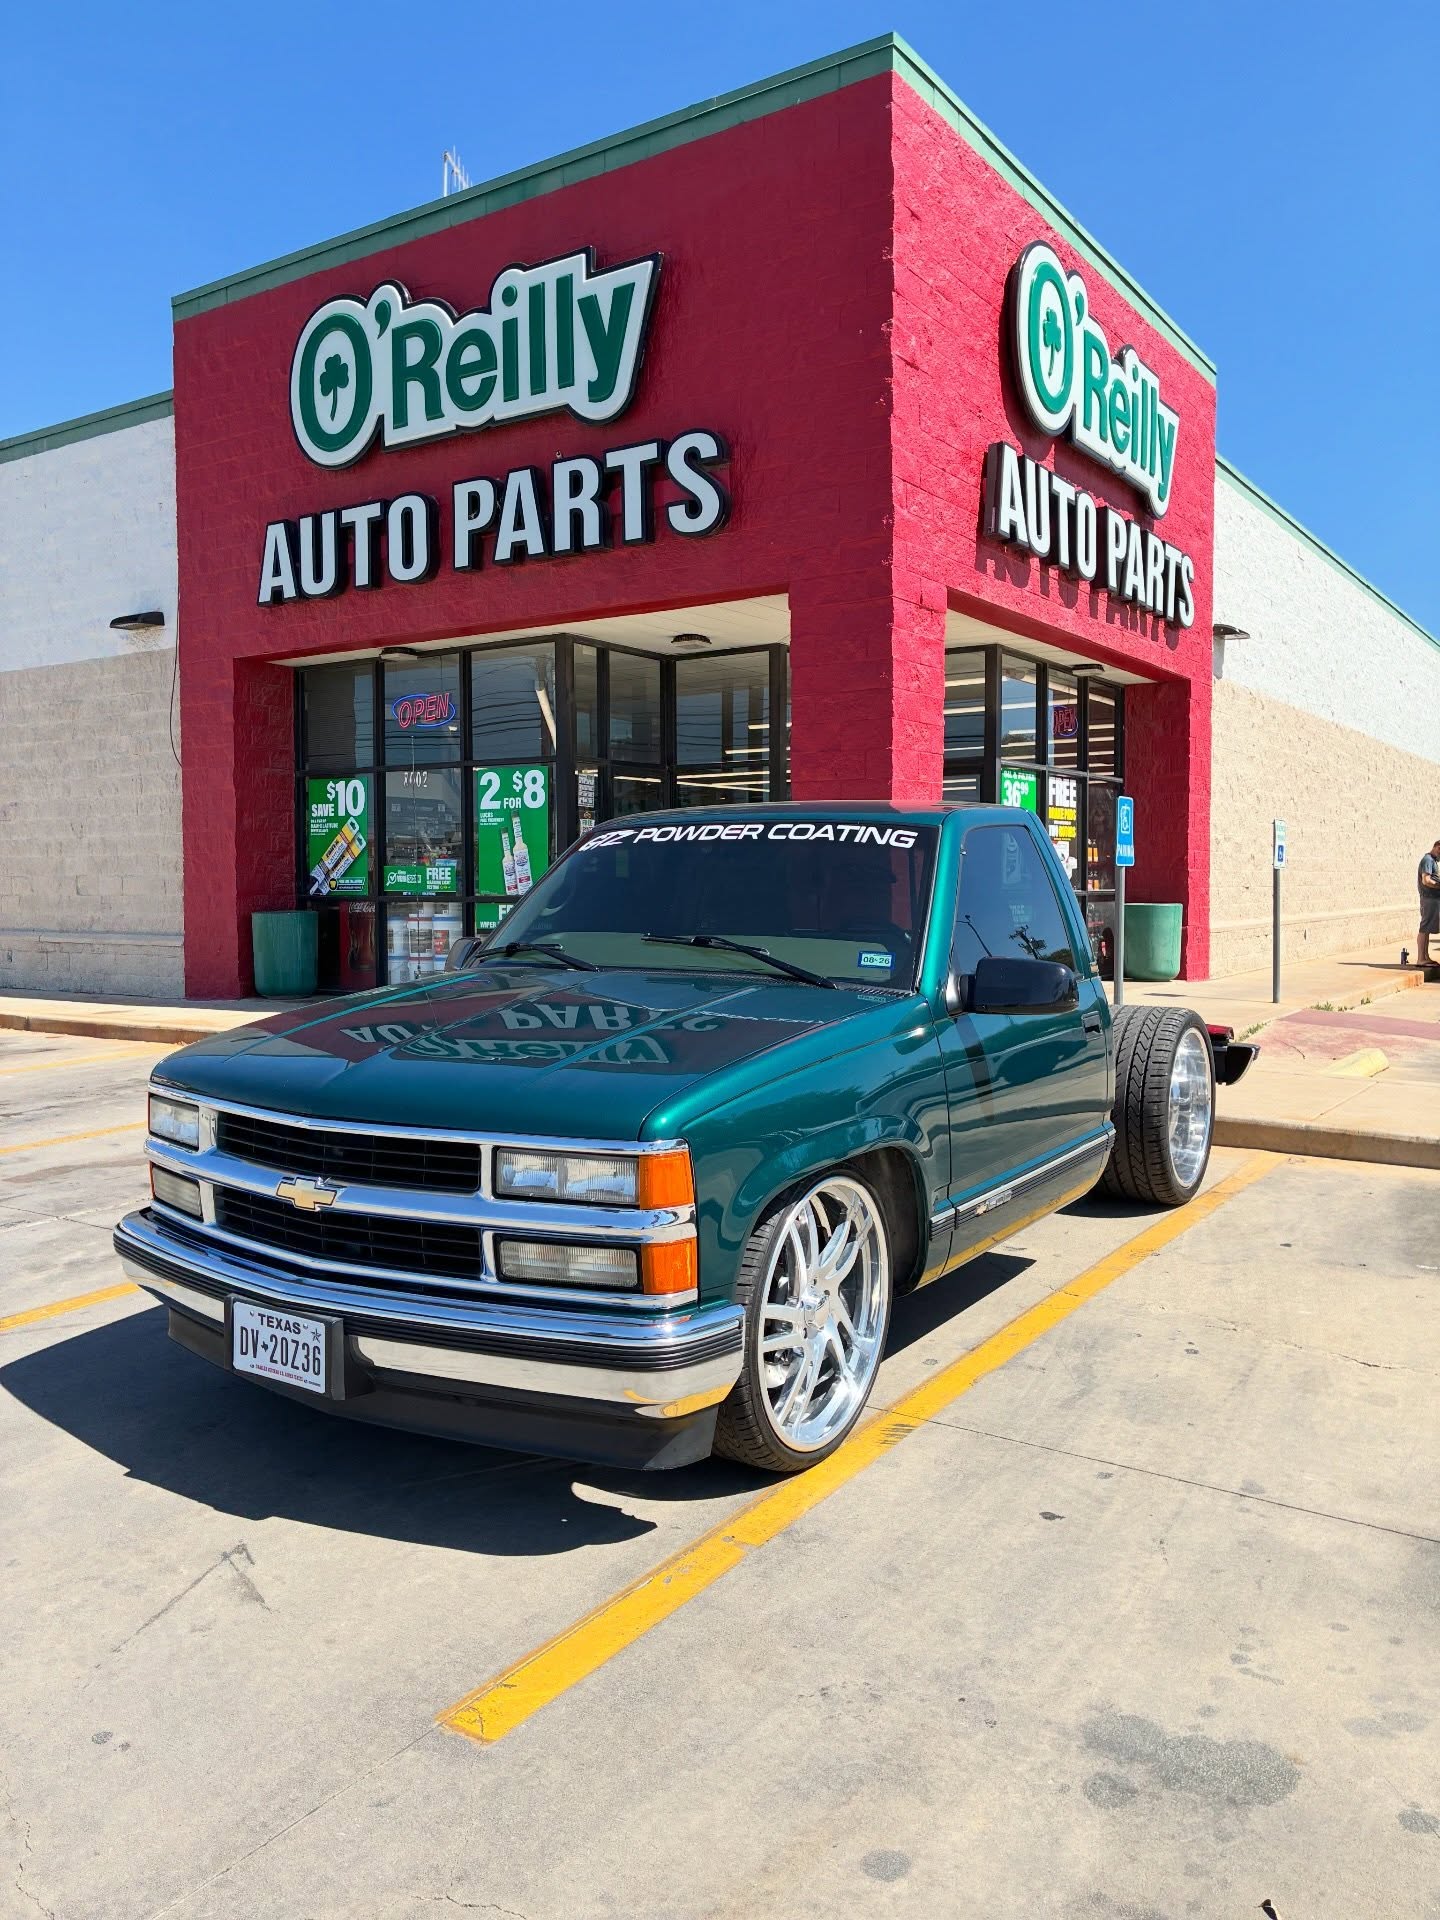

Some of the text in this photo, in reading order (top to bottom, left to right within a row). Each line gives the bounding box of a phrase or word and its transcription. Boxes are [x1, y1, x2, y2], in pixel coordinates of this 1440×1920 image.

[299, 273, 635, 452] O'Reilly
[1028, 261, 1175, 501] O'Reilly
[259, 432, 722, 604] AUTO PARTS
[1000, 443, 1194, 628] AUTO PARTS
[398, 692, 449, 728] OPEN
[311, 779, 366, 817] SAVE $10
[480, 771, 501, 809] 2
[503, 797, 521, 809] FOR
[512, 769, 546, 808] $8
[1048, 776, 1077, 808] FREE
[633, 824, 763, 844] POWDER
[768, 823, 918, 849] COATING
[426, 867, 452, 880] FREE
[480, 921, 497, 929] WIPER
[258, 1312, 301, 1335] TEXAS
[240, 1325, 259, 1359] DV
[269, 1333, 321, 1377] 20Z36
